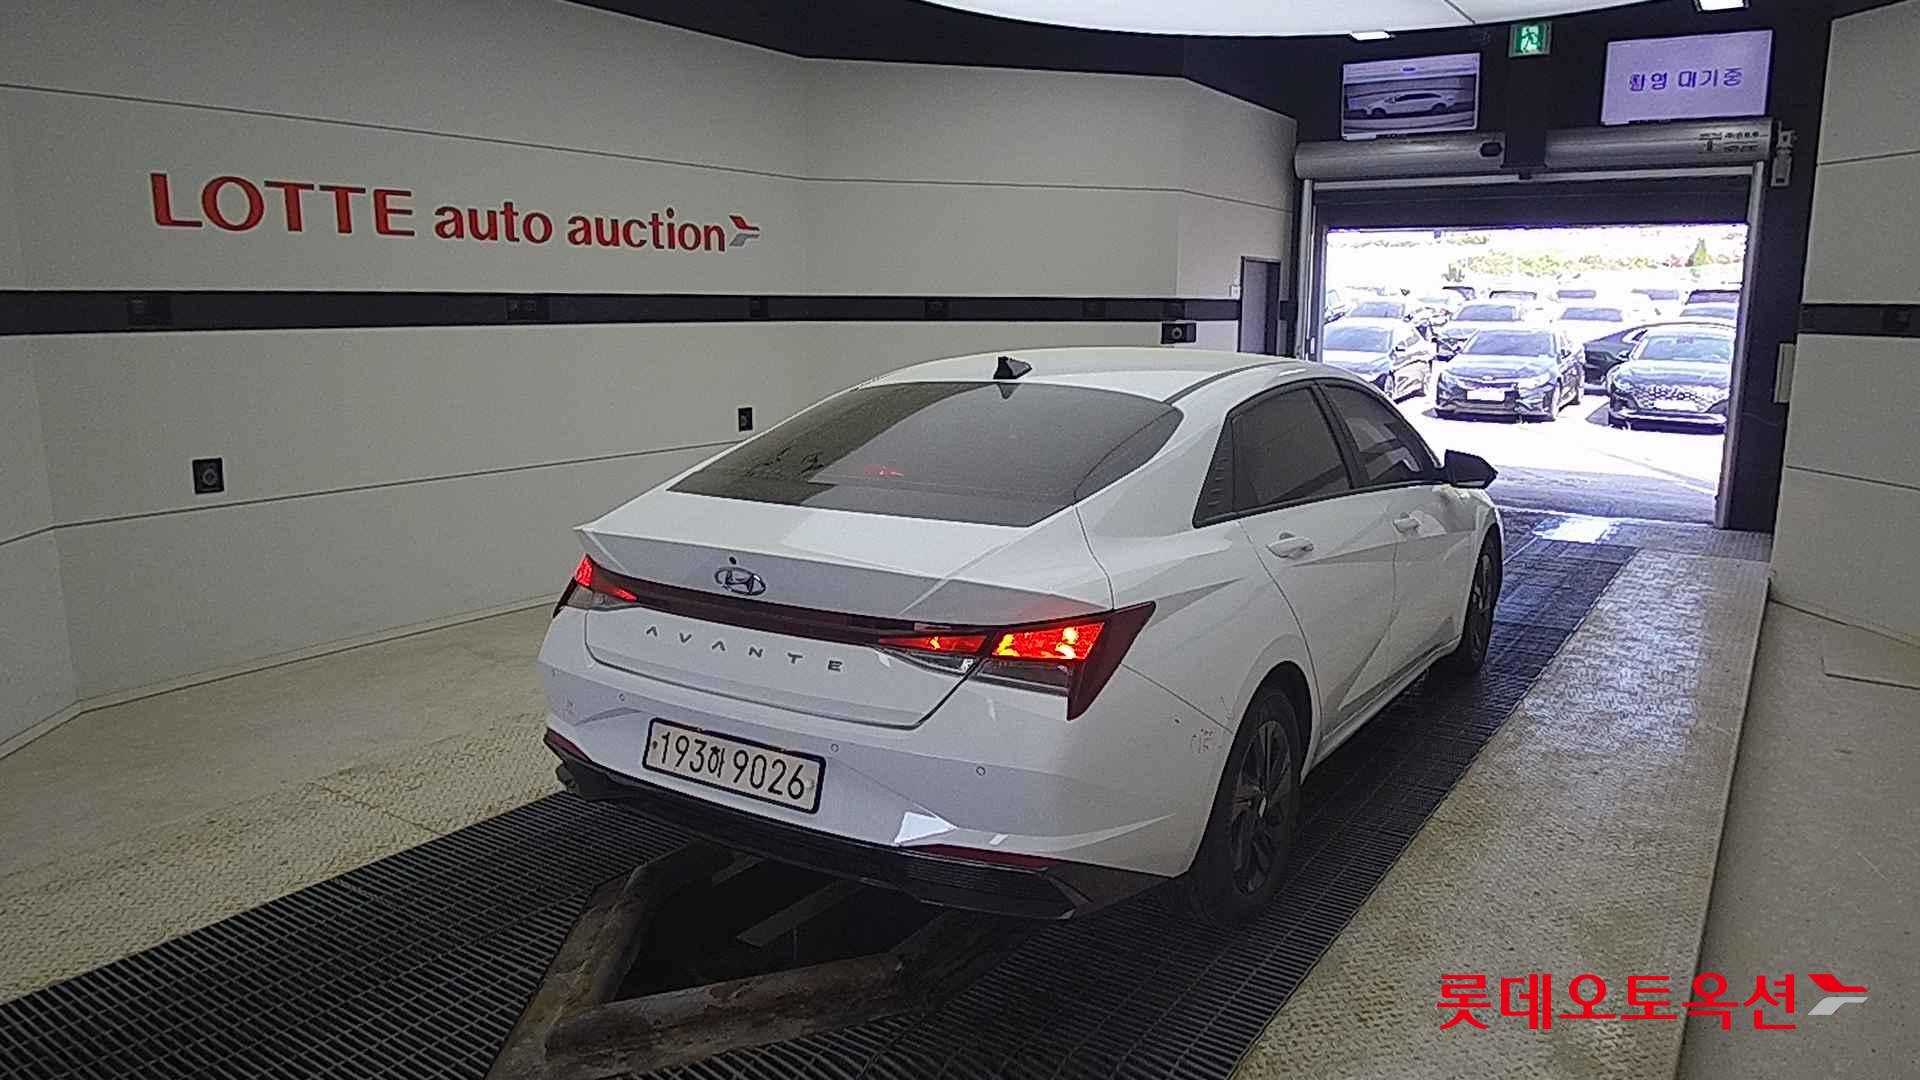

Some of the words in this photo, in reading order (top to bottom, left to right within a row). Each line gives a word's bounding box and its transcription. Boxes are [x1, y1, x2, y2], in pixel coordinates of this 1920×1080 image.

[1678, 67, 1743, 89] 대기중
[150, 173, 416, 237] LOTTE
[433, 201, 553, 245] auto
[567, 207, 726, 253] auction
[646, 625, 844, 673] AVANTE
